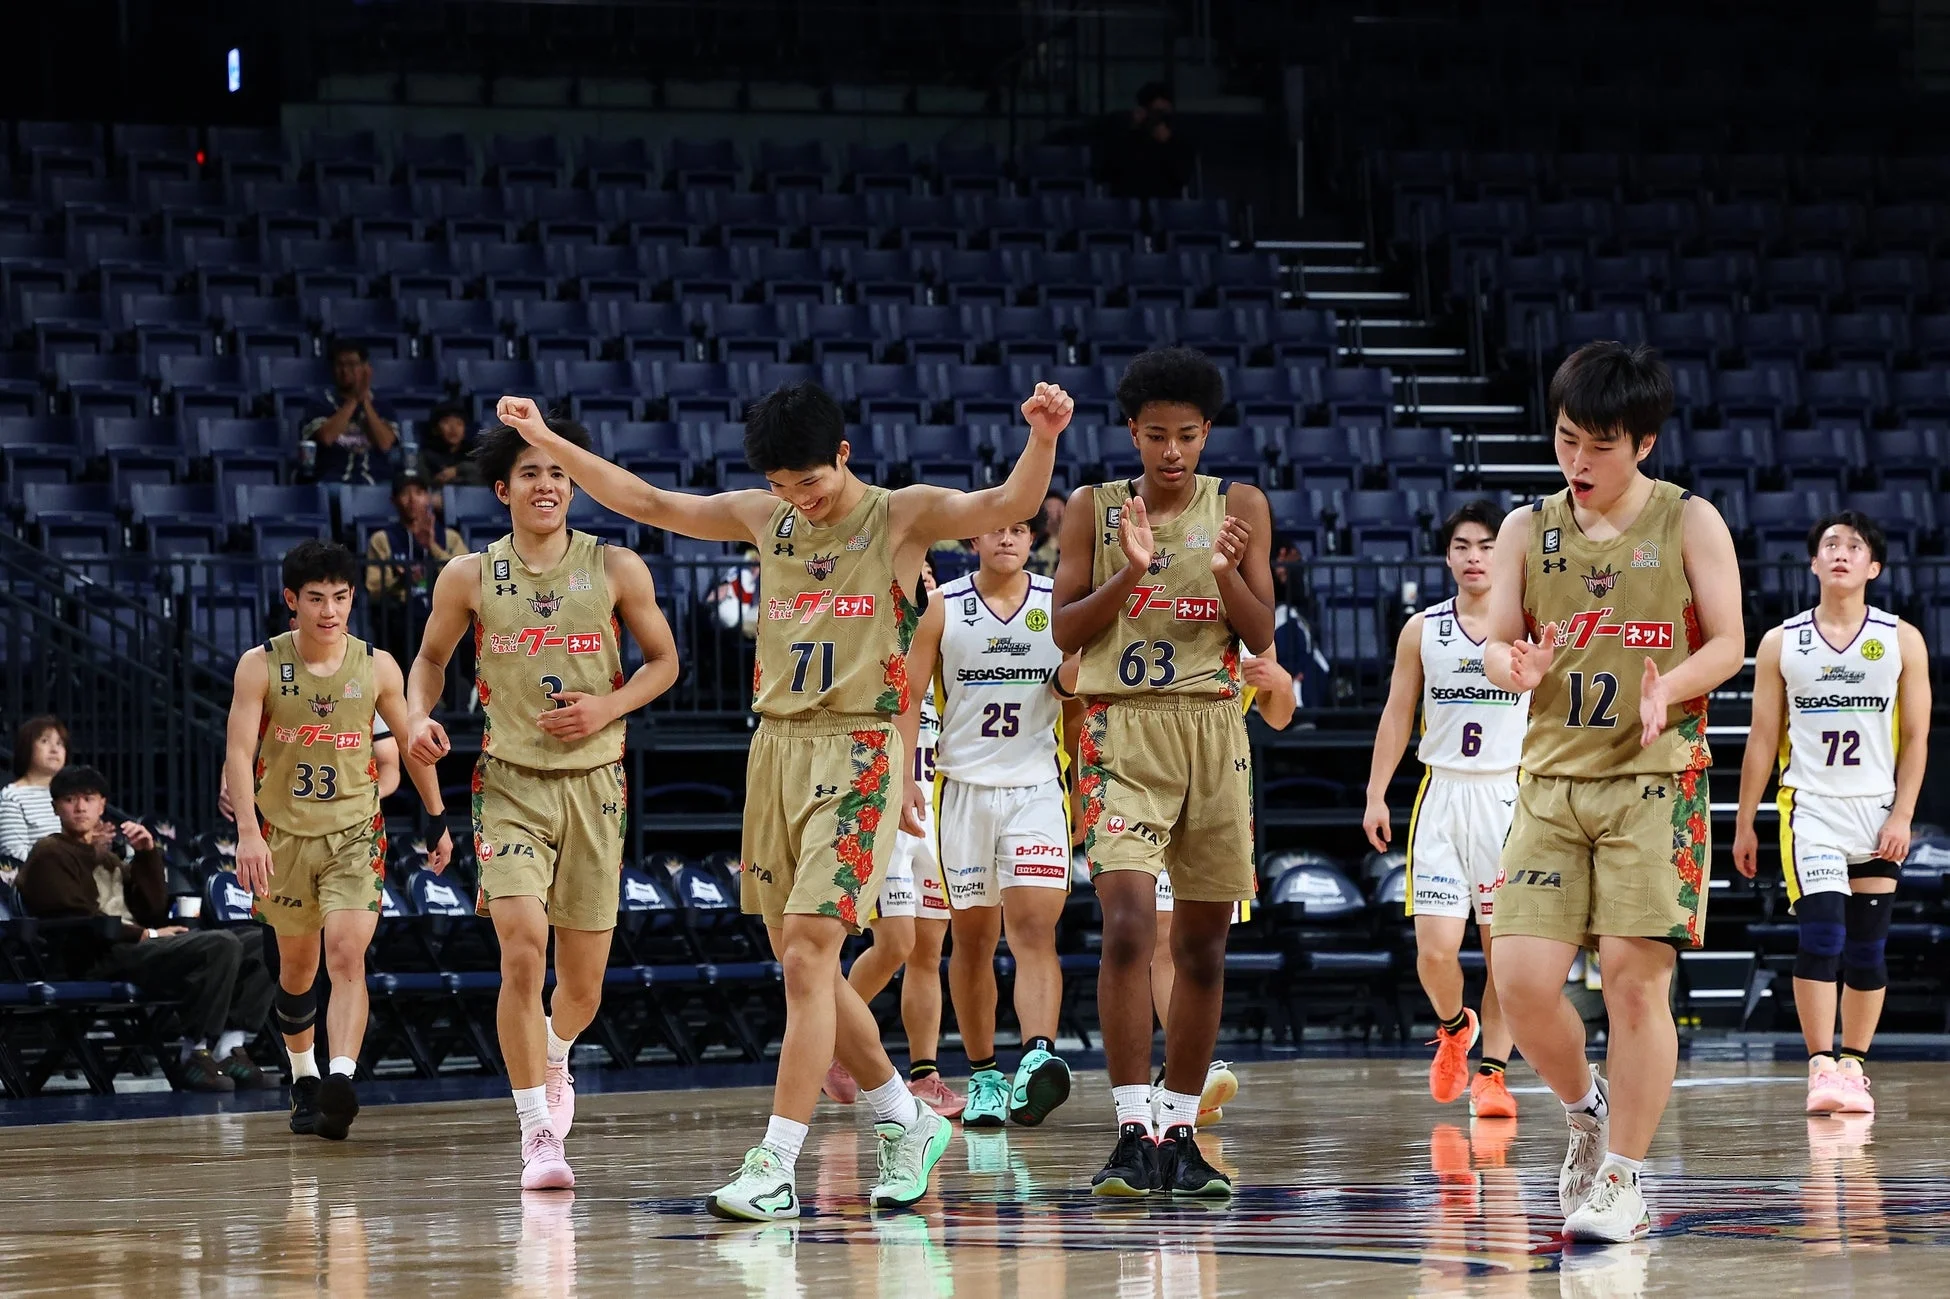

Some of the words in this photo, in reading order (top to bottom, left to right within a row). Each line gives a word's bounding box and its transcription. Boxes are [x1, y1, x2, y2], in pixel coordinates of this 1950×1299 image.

[835, 598, 873, 616] ネット
[1176, 599, 1217, 619] ネット
[1567, 608, 1623, 649] グー
[1625, 624, 1671, 646] ネット
[569, 636, 600, 652] ネット
[789, 642, 835, 693] 71
[1118, 640, 1177, 688] 63
[957, 667, 1052, 684] SEGASammy
[1565, 672, 1619, 729] 12
[1795, 695, 1889, 712] SEGASammy
[981, 703, 1022, 737] 25
[337, 735, 360, 748] ネット
[1462, 722, 1482, 757] 6
[1822, 730, 1860, 766] 72
[292, 762, 338, 801] 33
[1128, 821, 1159, 845] JTA
[497, 843, 534, 858] JTA
[1016, 845, 1064, 857] ロックアイス
[749, 862, 773, 884] JTA
[1508, 869, 1561, 887] JTA
[271, 895, 302, 908] JTA
